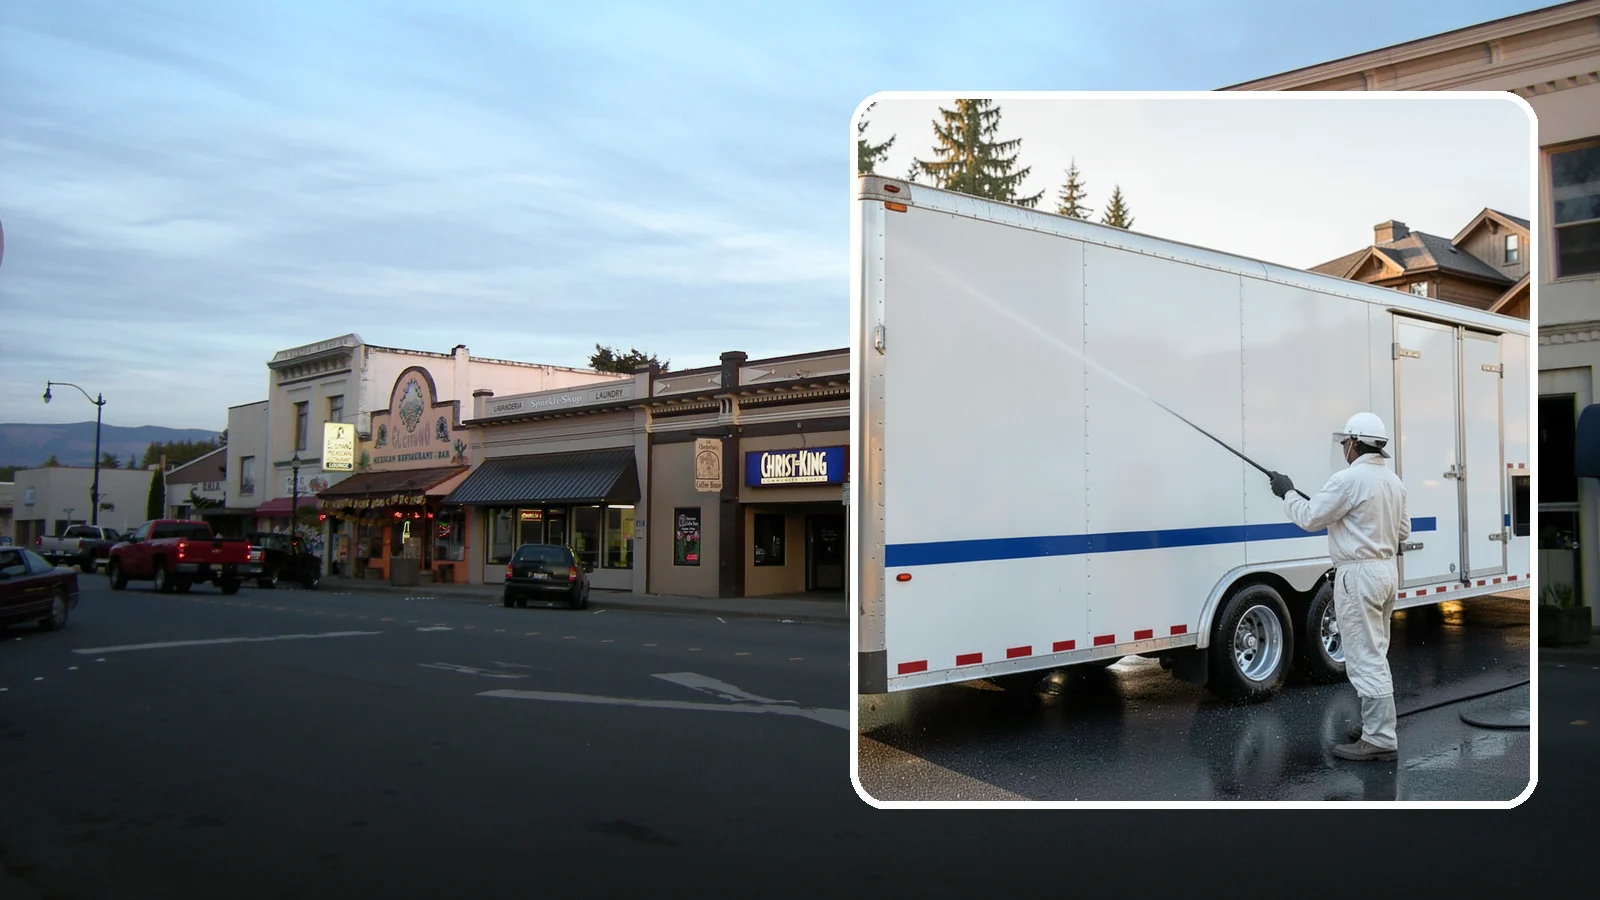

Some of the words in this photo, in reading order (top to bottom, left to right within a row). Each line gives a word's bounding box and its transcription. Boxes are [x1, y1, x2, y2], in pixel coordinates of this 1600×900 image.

[531, 397, 560, 409] Sparkle
[560, 394, 582, 405] Shop
[595, 389, 624, 400] LAUNDRY
[493, 402, 522, 413] LAVANDERIA
[374, 454, 397, 464] MEXICAN
[397, 451, 434, 462] RESTAURANT
[438, 449, 450, 459] BAR
[761, 452, 797, 477] CHRIST
[799, 450, 827, 476] KING
